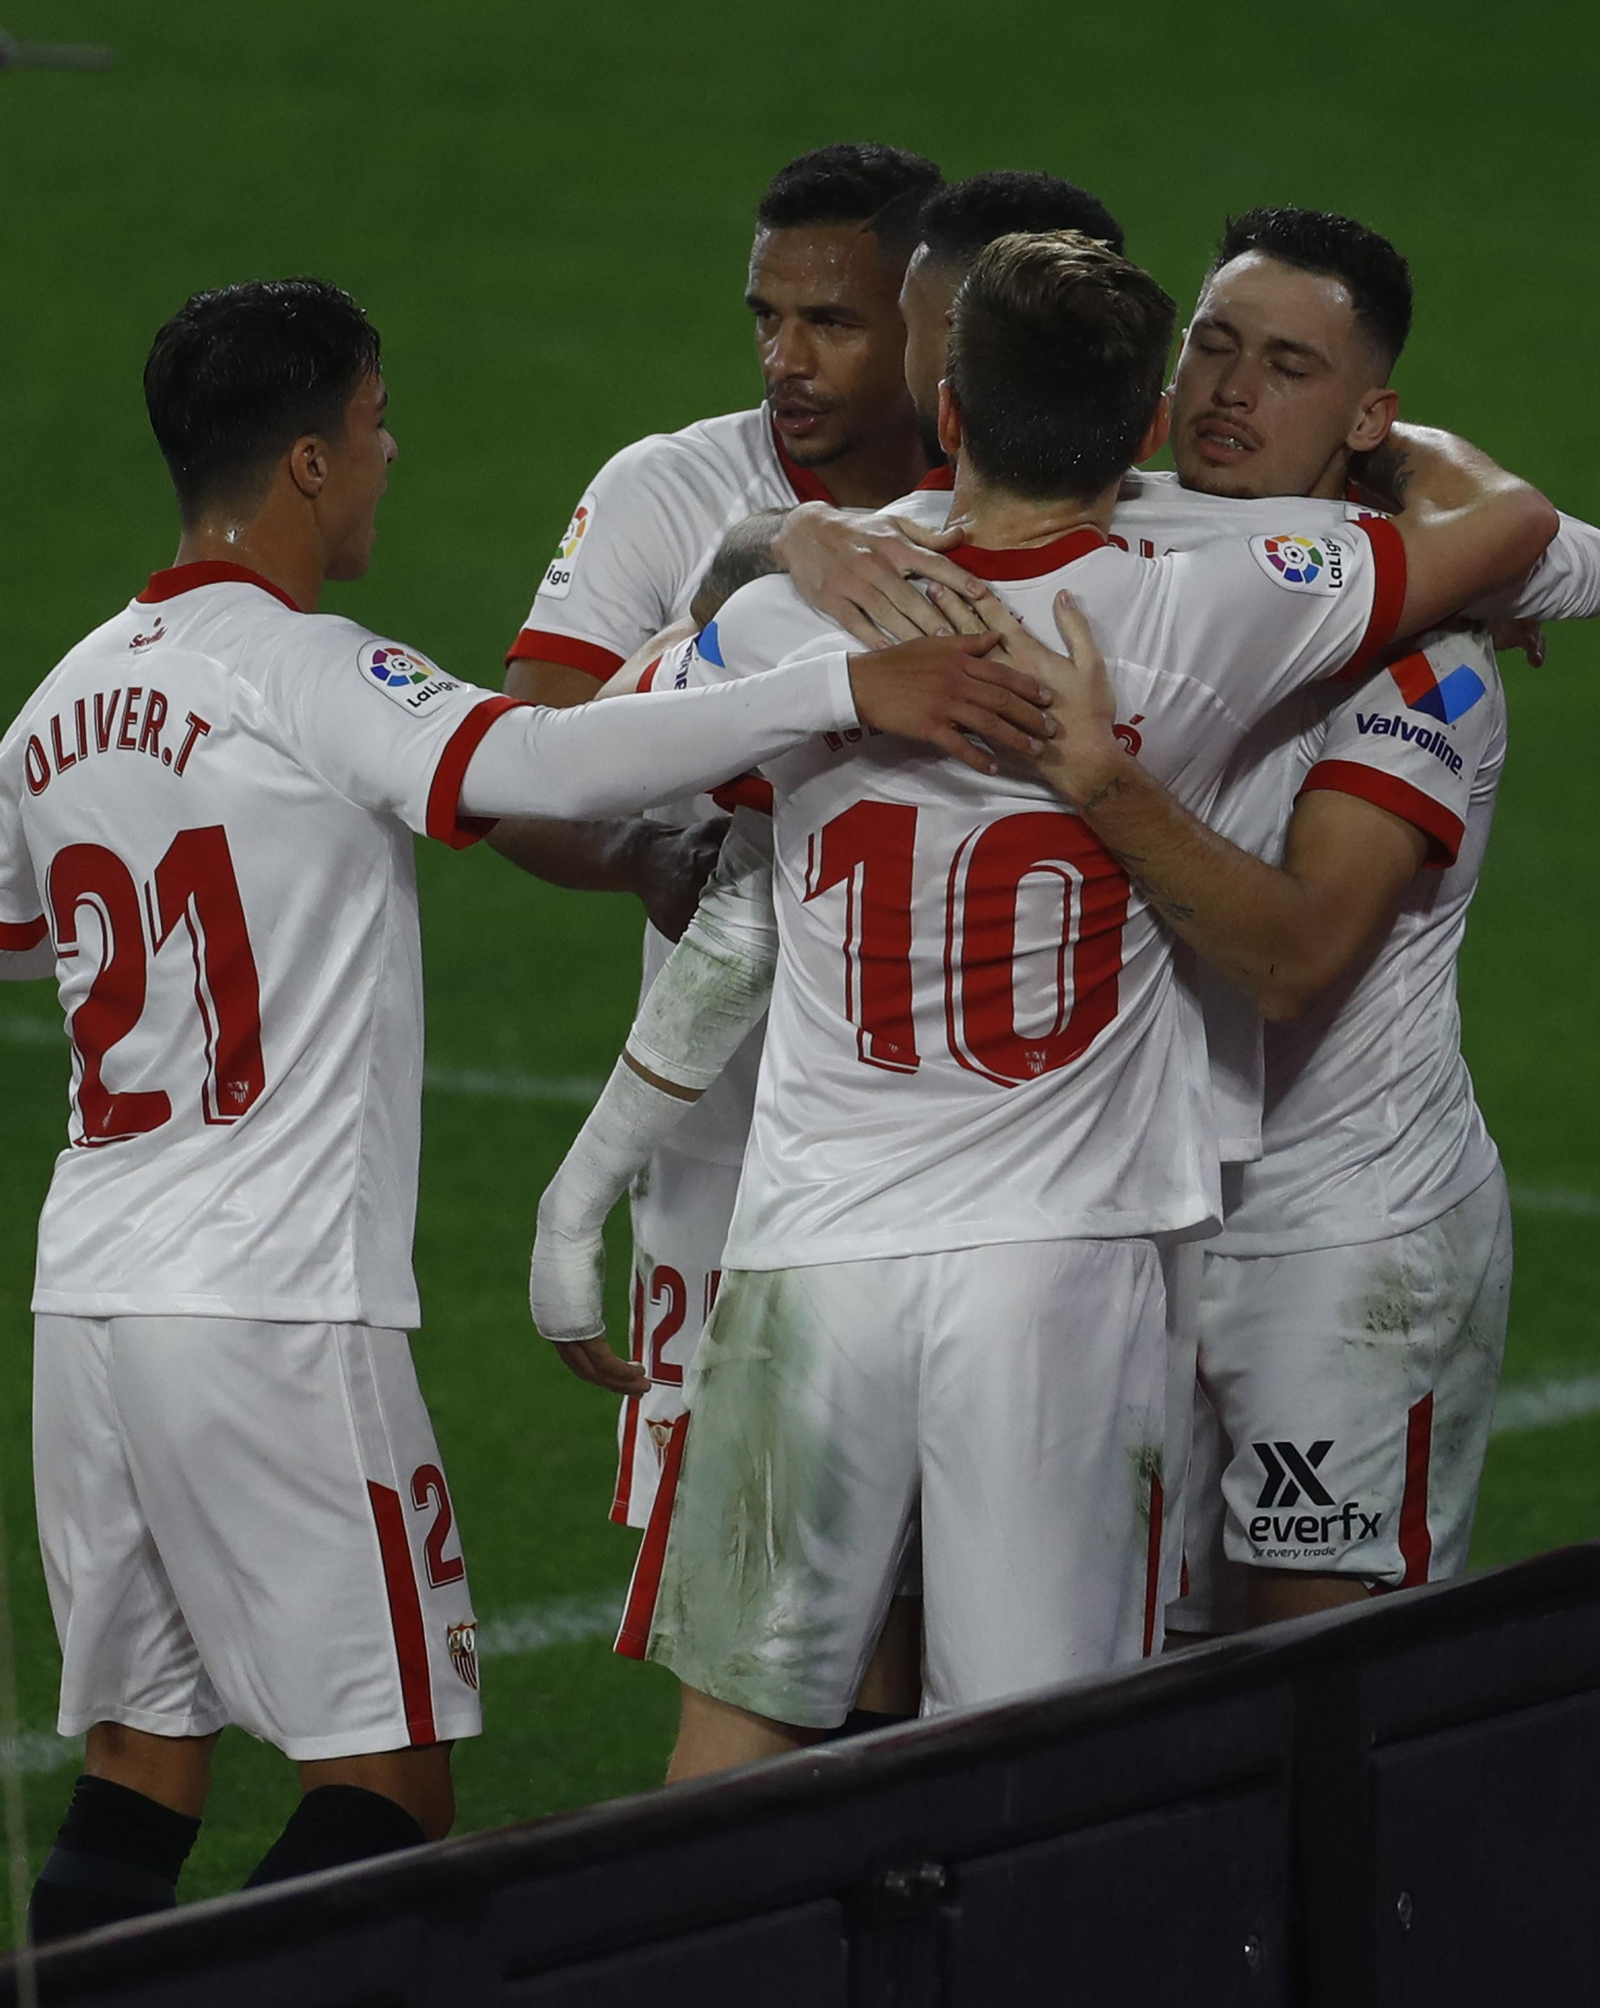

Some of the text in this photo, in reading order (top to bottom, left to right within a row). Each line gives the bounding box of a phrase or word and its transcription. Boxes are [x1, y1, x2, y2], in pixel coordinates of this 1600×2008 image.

[547, 564, 570, 585] iga
[1320, 537, 1342, 588] LaLiga
[407, 681, 459, 708] LaLiga
[25, 687, 212, 797] OLIVER.T
[1356, 712, 1463, 777] Valvoline
[801, 799, 1131, 1090] 10
[45, 824, 266, 1147] 21
[410, 1463, 465, 1589] 2
[1250, 1502, 1382, 1543] everfx
[1266, 1548, 1301, 1560] every
[1303, 1546, 1336, 1557] trade
